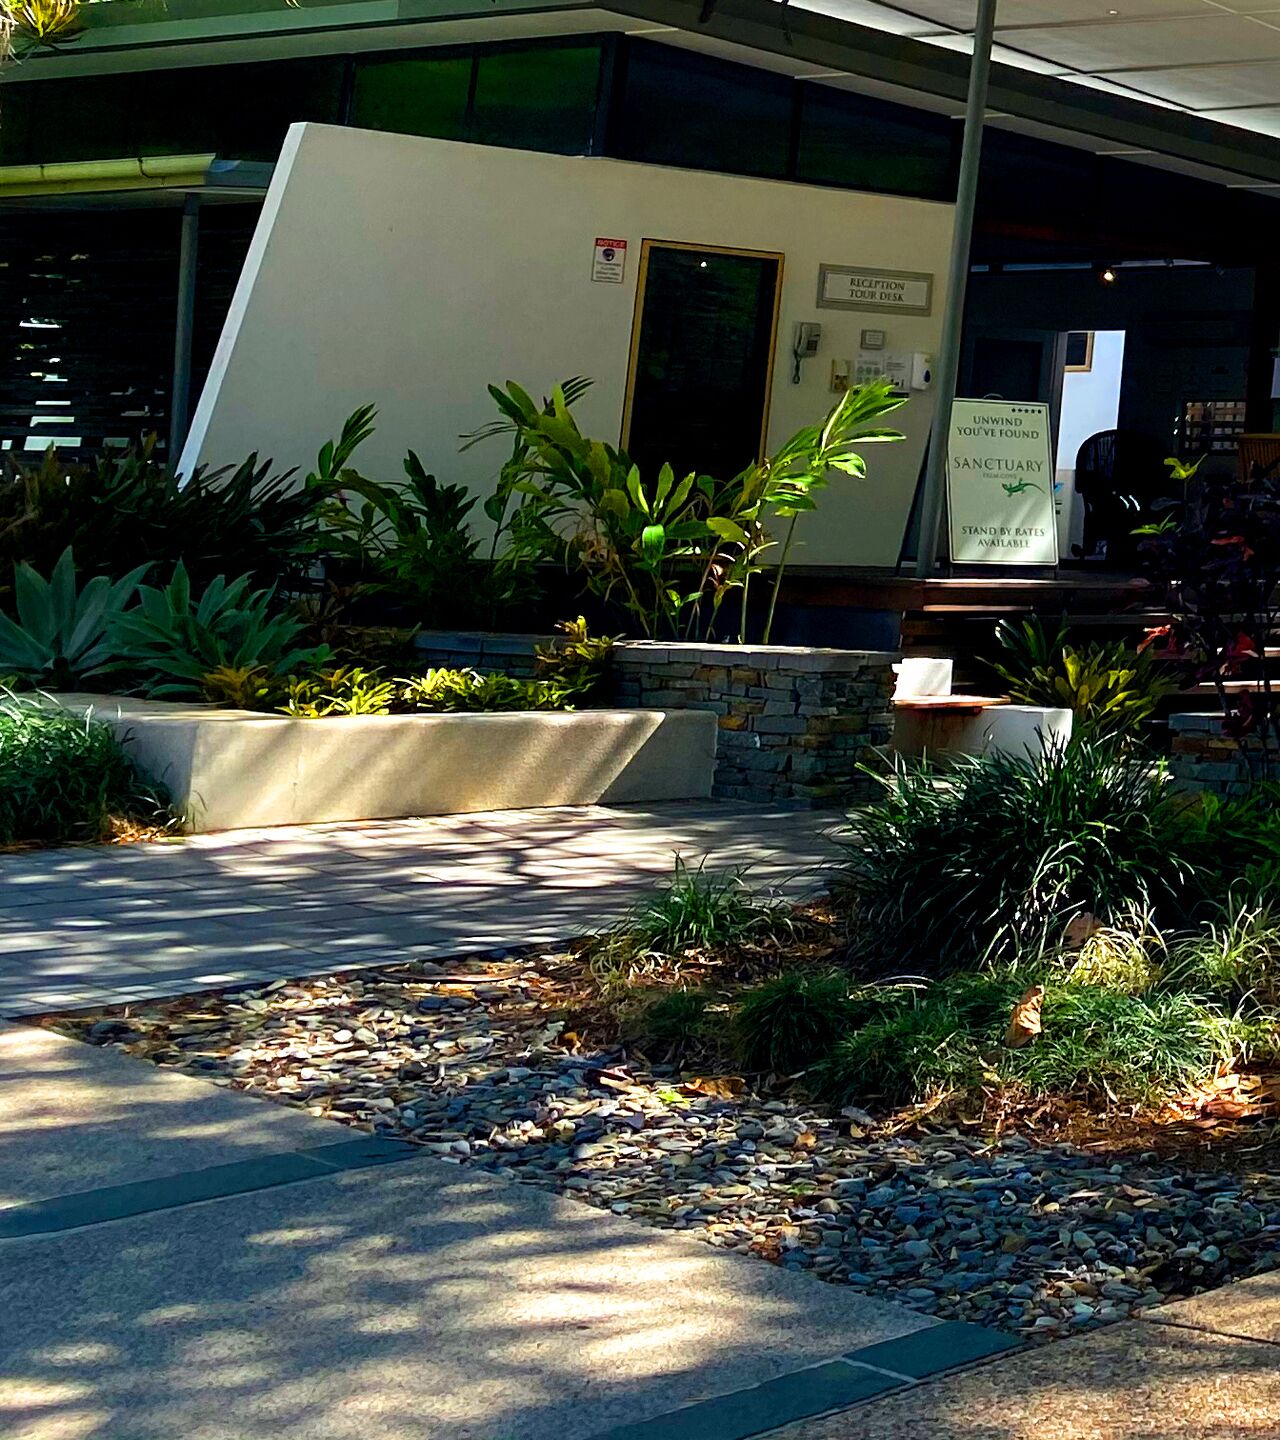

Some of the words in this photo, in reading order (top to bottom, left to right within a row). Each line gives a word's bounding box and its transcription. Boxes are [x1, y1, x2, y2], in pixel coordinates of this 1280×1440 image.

[849, 277, 906, 291] RECEPTION
[848, 288, 877, 300] TOUR
[879, 291, 905, 302] DESK
[972, 415, 1023, 427] UNWIND
[956, 426, 997, 438] YOU'VE
[999, 428, 1040, 440] FOUND
[953, 456, 1044, 473] SANCTUARY
[961, 525, 997, 536] STAND
[999, 527, 1012, 536] BY
[1015, 527, 1045, 537] RATES
